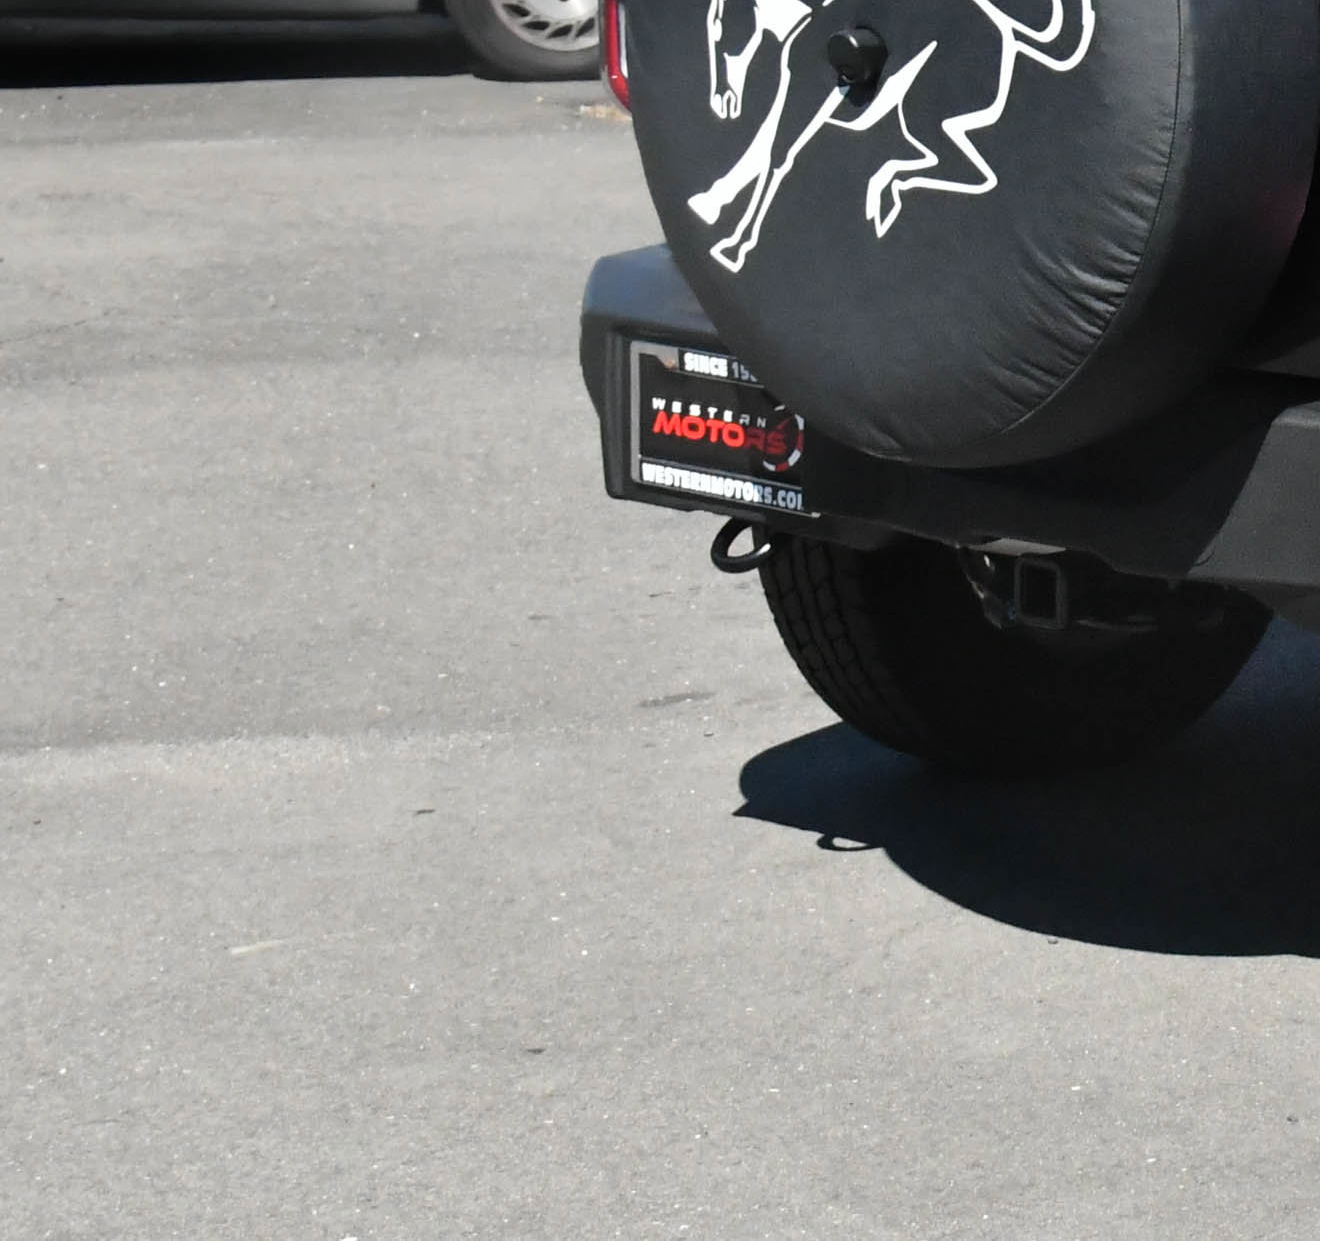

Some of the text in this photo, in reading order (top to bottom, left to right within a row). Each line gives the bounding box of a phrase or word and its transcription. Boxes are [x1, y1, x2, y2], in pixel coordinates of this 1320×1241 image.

[683, 351, 729, 379] SINCE
[651, 397, 768, 429] WESTERN
[652, 410, 788, 455] MOTORS
